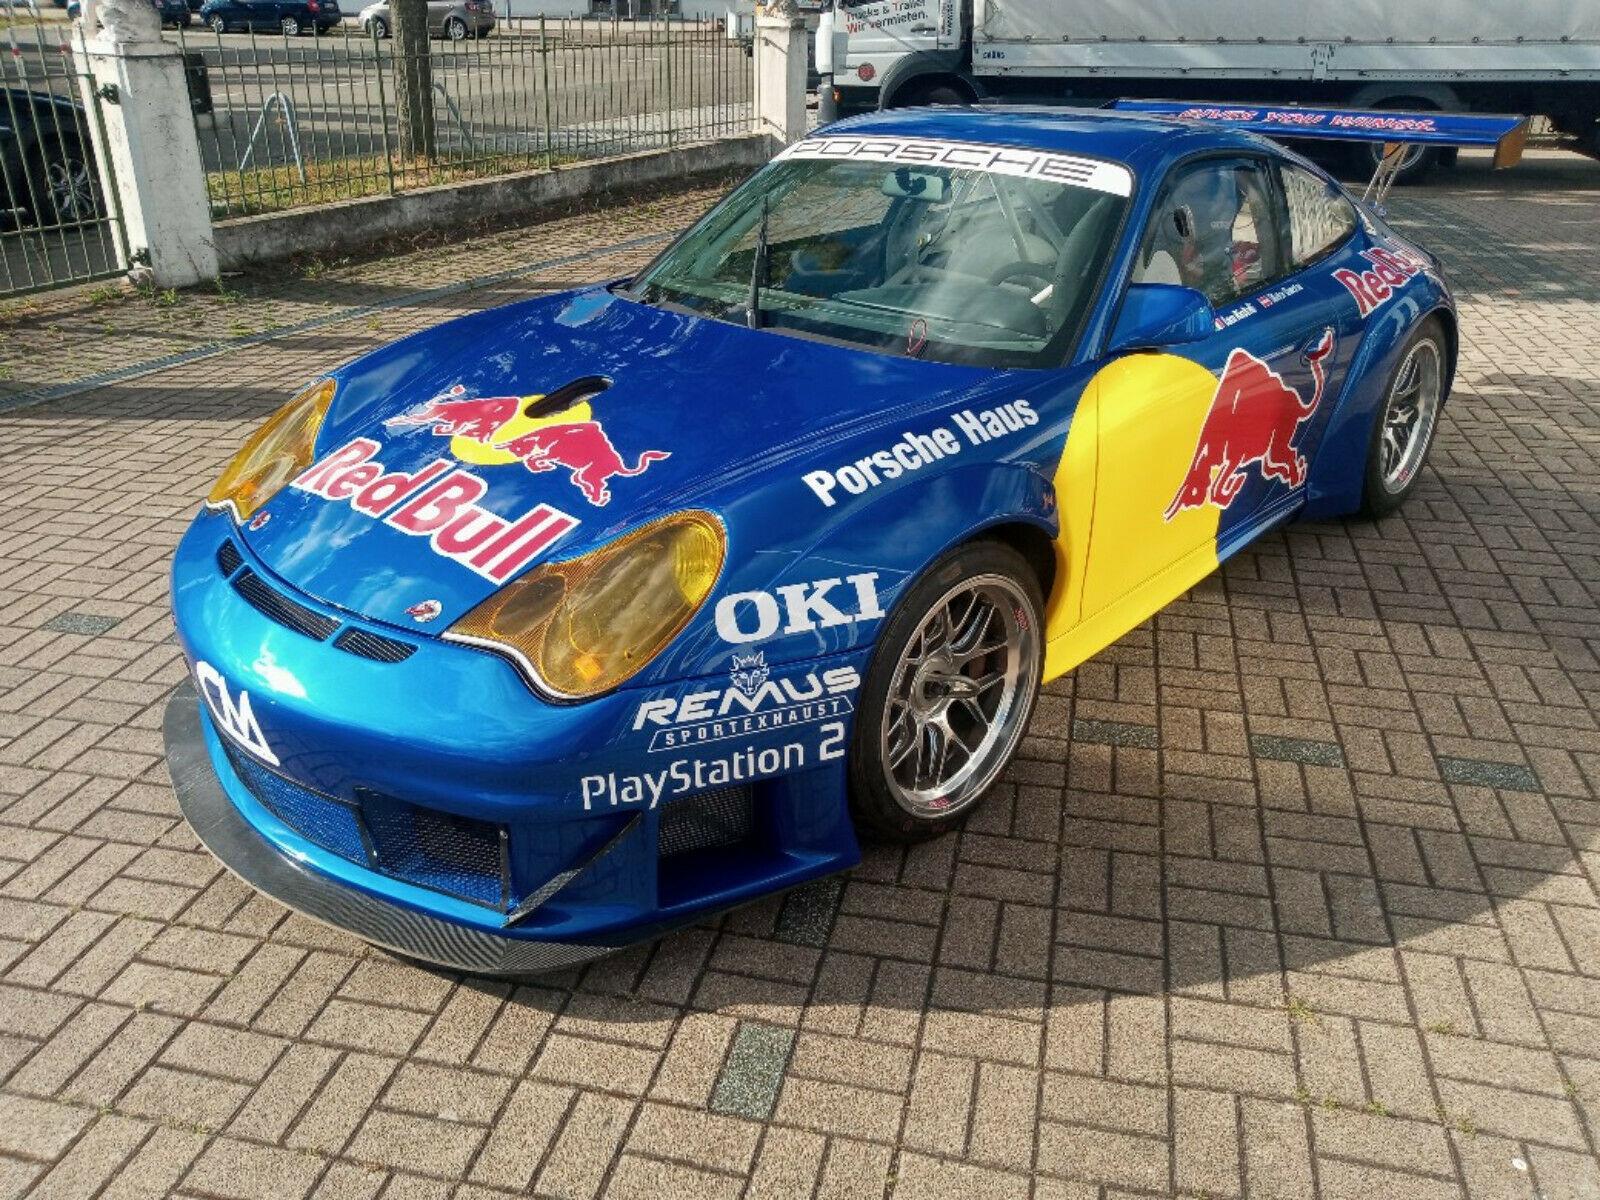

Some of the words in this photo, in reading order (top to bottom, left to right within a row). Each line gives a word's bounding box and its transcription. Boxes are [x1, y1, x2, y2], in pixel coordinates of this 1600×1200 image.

[846, 21, 866, 34] Wir
[868, 10, 929, 28] vermieten.
[788, 141, 1098, 182] PORSCHE
[801, 427, 961, 507] Porsche
[951, 399, 1039, 446] Haus
[714, 572, 886, 644] OKI
[632, 666, 861, 731] REMUS
[665, 701, 841, 746] SPORTEXHAUST
[581, 742, 804, 810] PlayStation
[819, 721, 846, 761] 2
